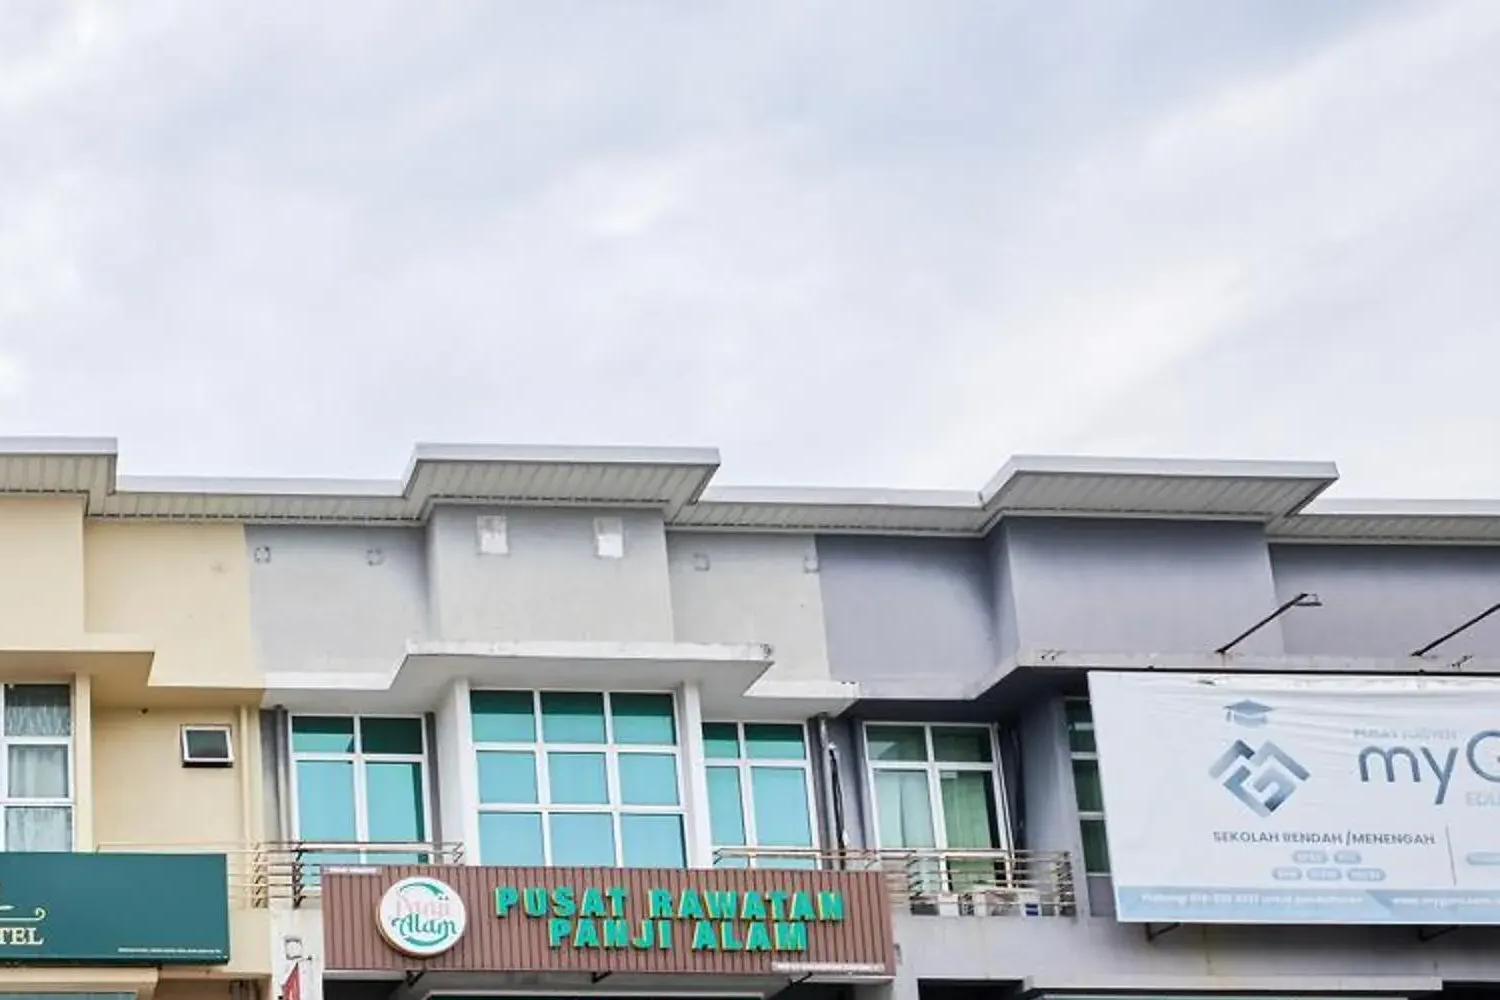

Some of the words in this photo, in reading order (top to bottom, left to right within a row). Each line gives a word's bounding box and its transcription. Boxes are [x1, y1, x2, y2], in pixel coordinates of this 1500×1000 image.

[1212, 831, 1280, 844] SEKOLAH
[1283, 832, 1343, 844] RENDAH
[494, 886, 629, 918] PUSAT
[648, 887, 845, 922] RAWATAN
[391, 913, 458, 938] Alam
[548, 918, 672, 950] PANJI
[691, 919, 808, 952] ALAM
